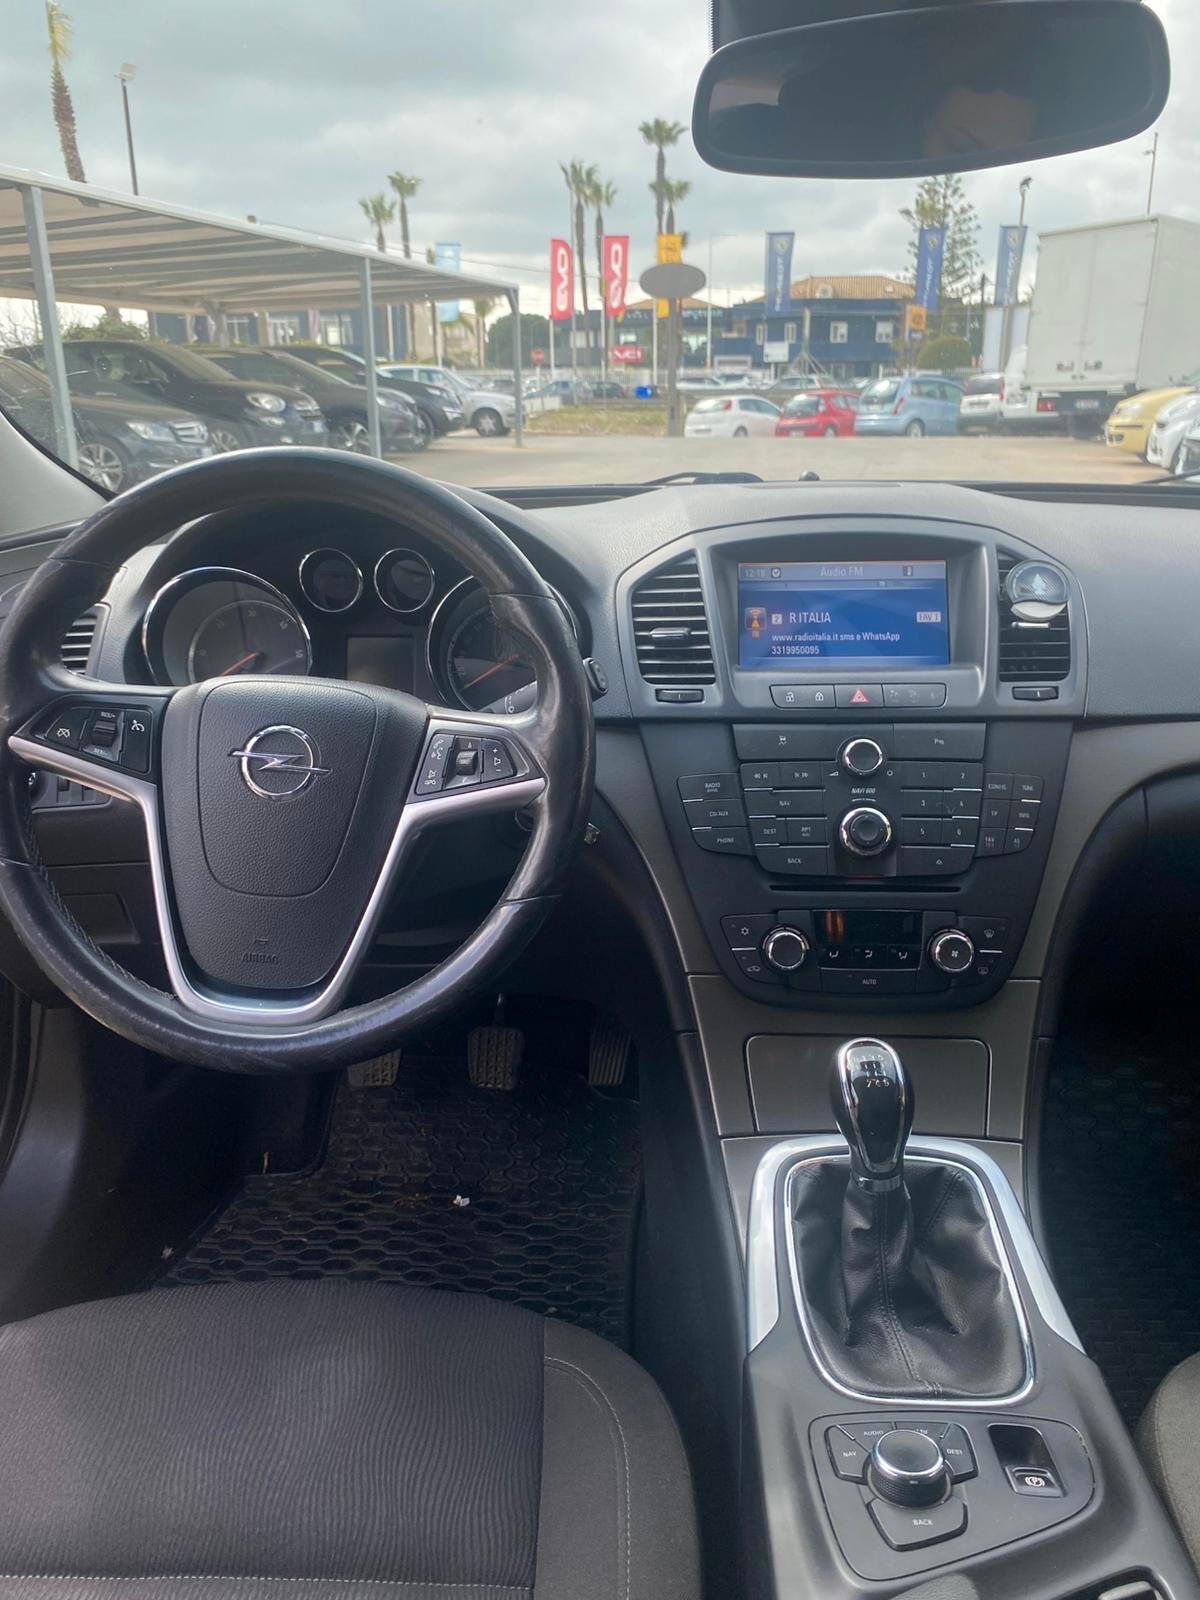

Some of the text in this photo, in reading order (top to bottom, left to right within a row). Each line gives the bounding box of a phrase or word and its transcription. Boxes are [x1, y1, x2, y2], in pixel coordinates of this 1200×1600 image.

[820, 566, 864, 578] Audio FM
[789, 612, 797, 624] R
[799, 612, 832, 623] ITALIA
[771, 633, 839, 642] www.radioitalia.it
[862, 632, 900, 642] WhatsApp
[771, 645, 820, 655] 3319950095
[862, 977, 877, 985] AUTO
